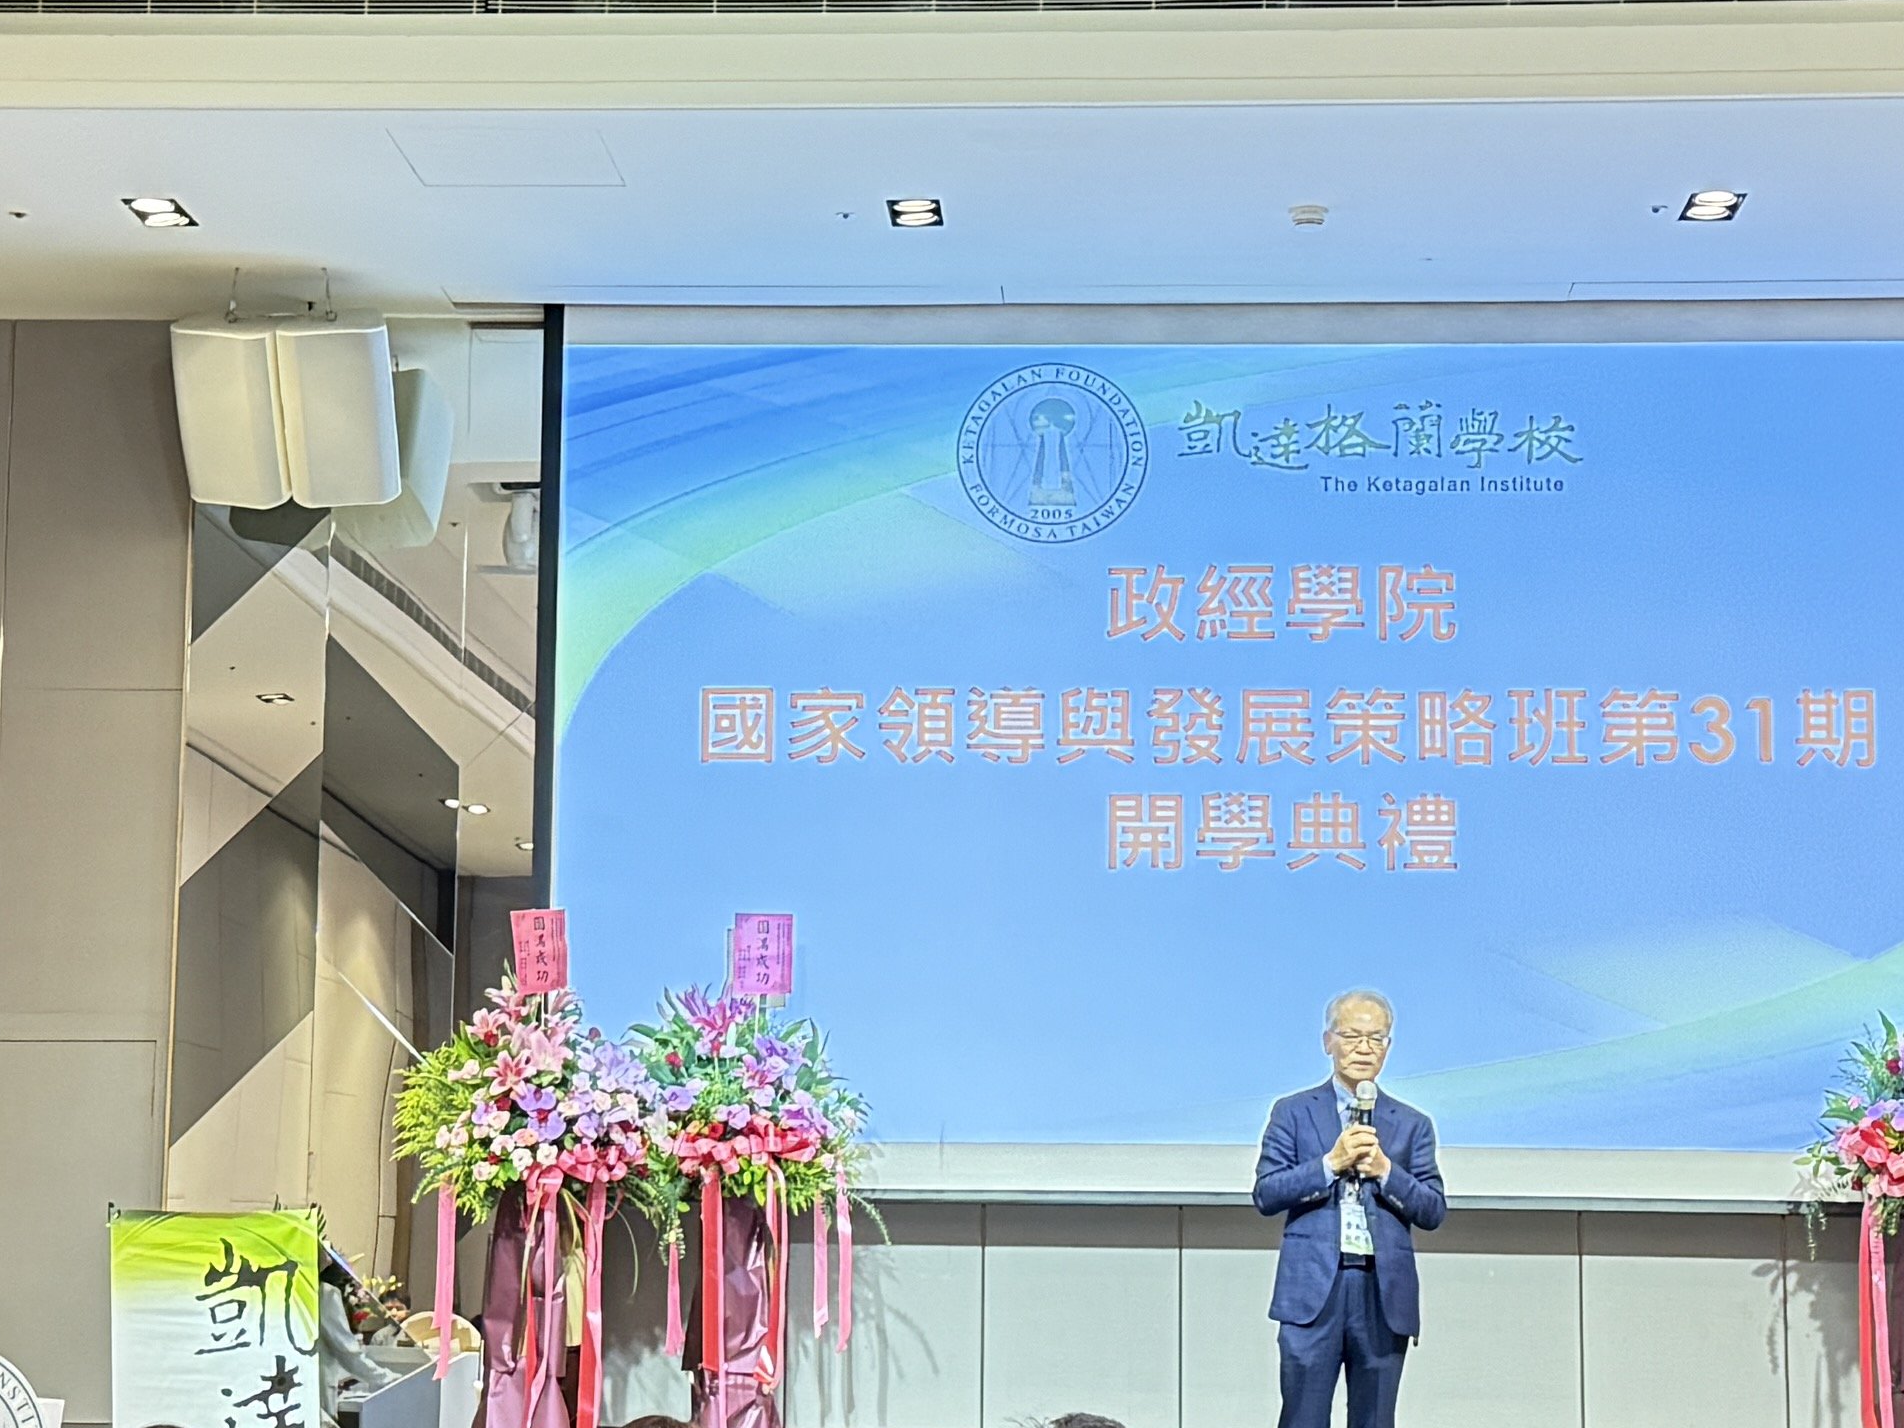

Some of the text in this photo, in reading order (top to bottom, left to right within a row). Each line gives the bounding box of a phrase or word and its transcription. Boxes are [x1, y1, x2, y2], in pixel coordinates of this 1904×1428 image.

[962, 368, 1144, 467] KETAGALAN FOUNDATION
[1177, 399, 1584, 470] 凱達格蘭學校
[970, 483, 1135, 539] FORMOSA TAIWAN
[1030, 508, 1074, 520] 2005
[1320, 475, 1565, 495] The Ketagalan Institute
[1106, 564, 1457, 641] 政經學院
[698, 685, 1880, 768] 國家領導與發展策略班第31期
[1106, 792, 1458, 871] 開學典禮
